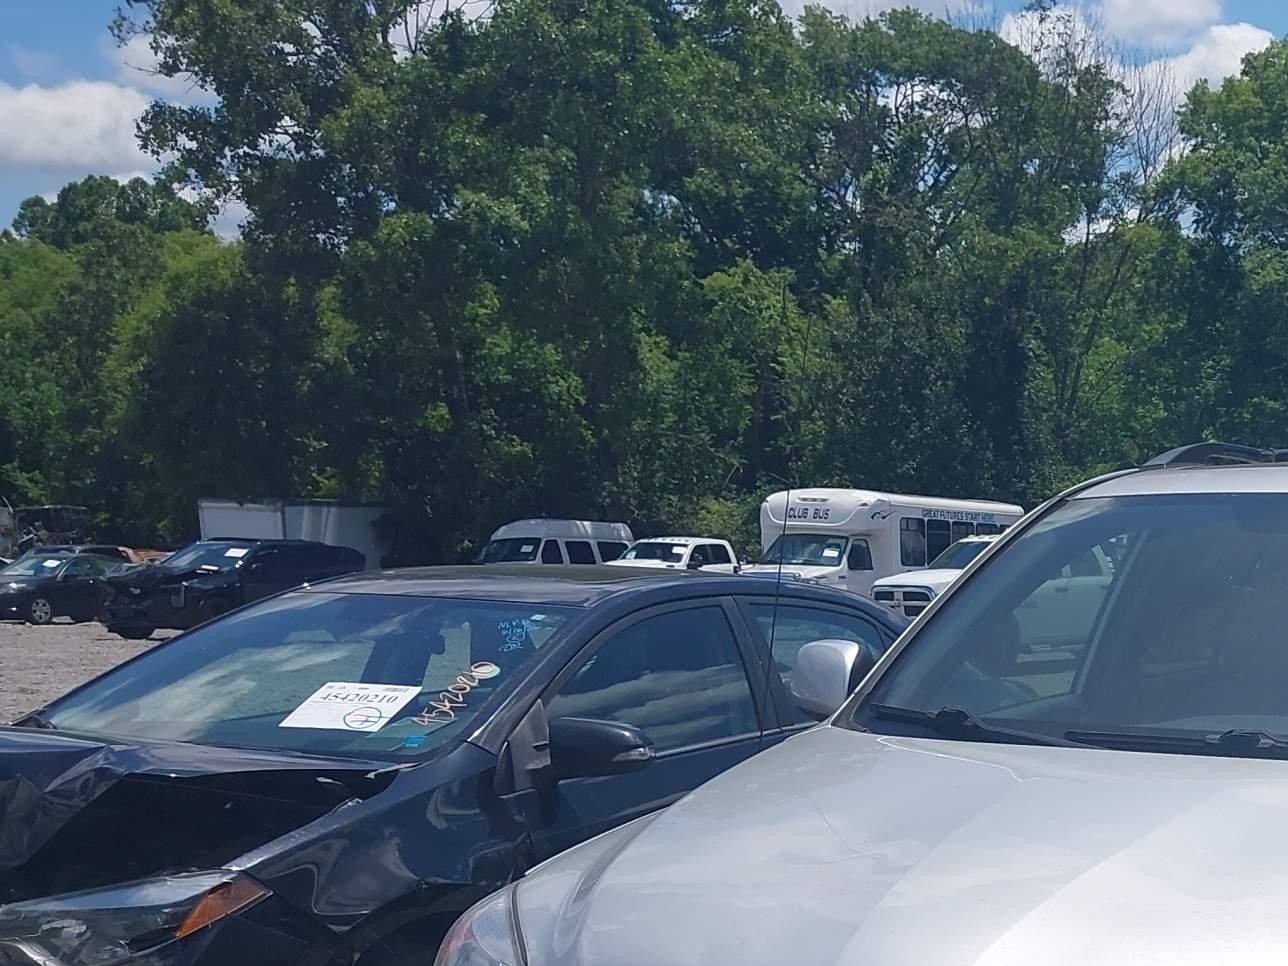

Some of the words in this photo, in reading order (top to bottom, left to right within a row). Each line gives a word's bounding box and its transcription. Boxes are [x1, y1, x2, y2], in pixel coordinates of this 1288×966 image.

[788, 507, 808, 519] CLUB
[813, 508, 830, 520] BUS
[921, 508, 940, 519] GREAT
[940, 510, 964, 521] FUTURES
[965, 512, 981, 522] START
[319, 692, 399, 704] 45420210
